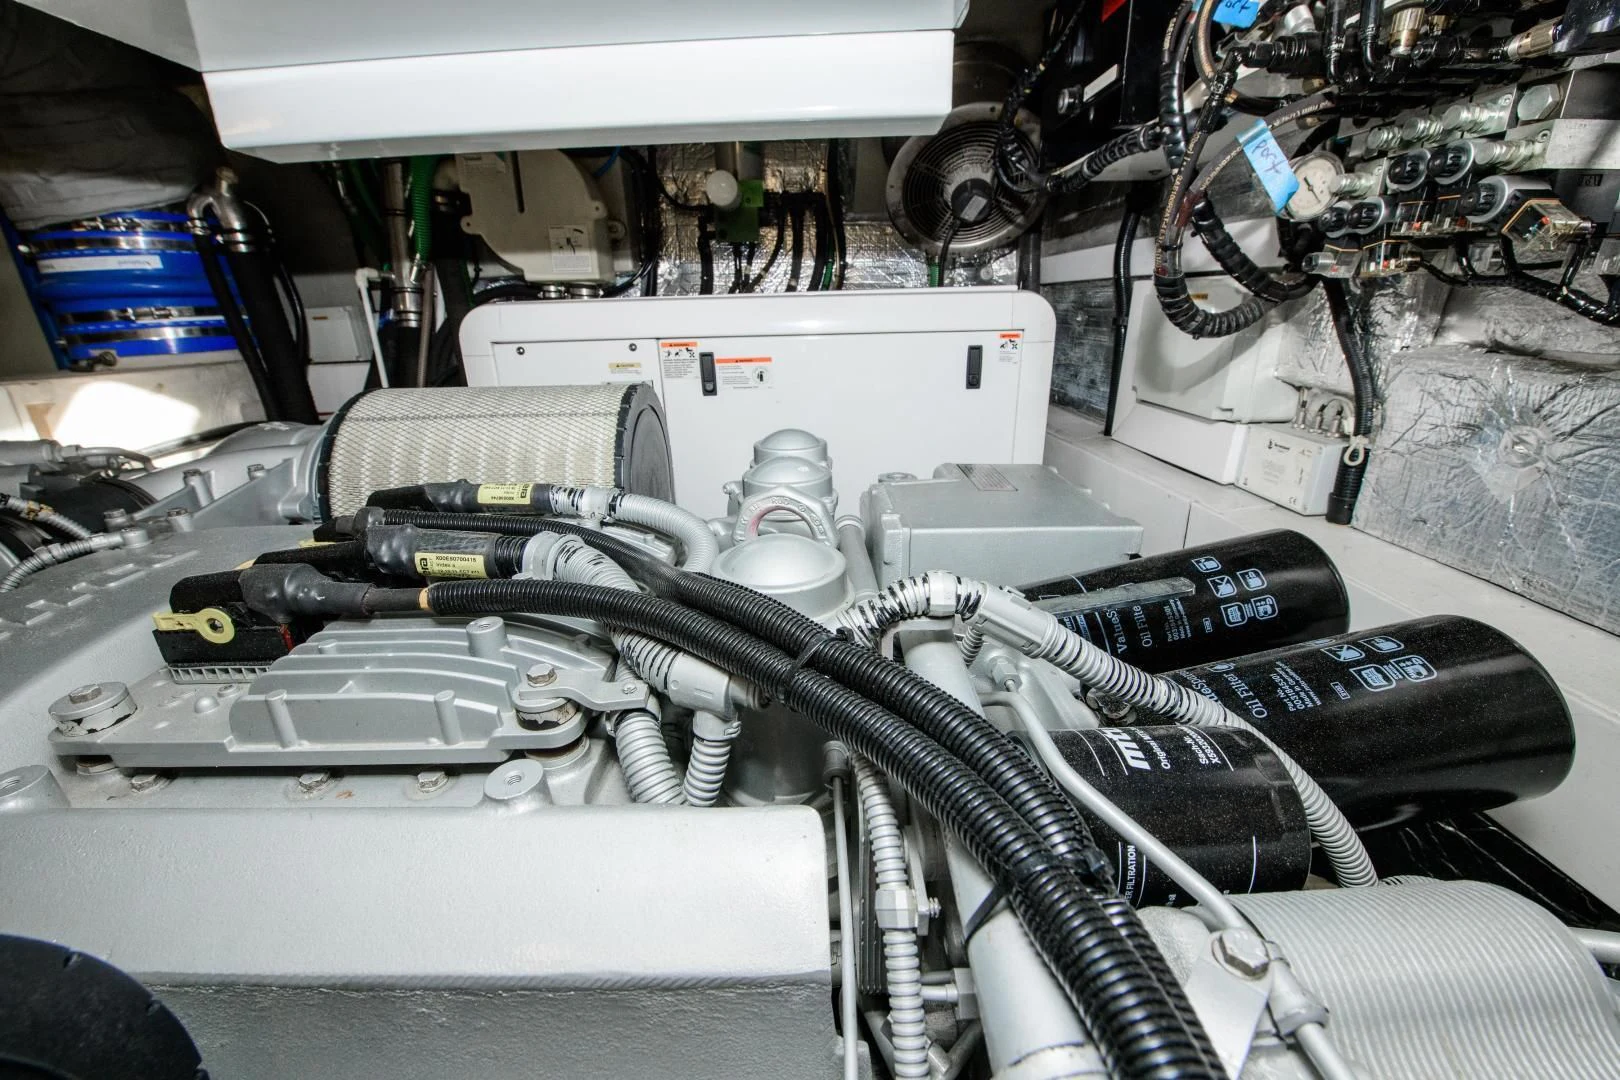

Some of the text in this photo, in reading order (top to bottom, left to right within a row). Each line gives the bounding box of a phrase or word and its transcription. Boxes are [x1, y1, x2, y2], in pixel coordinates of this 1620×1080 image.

[1133, 605, 1153, 647] Oil Filte
[1223, 673, 1268, 718] Oil Filter
[1276, 688, 1296, 711] Part No.
[1299, 692, 1314, 708] Made
[1146, 740, 1171, 769] Original
[1126, 845, 1136, 890] FILTRATION
